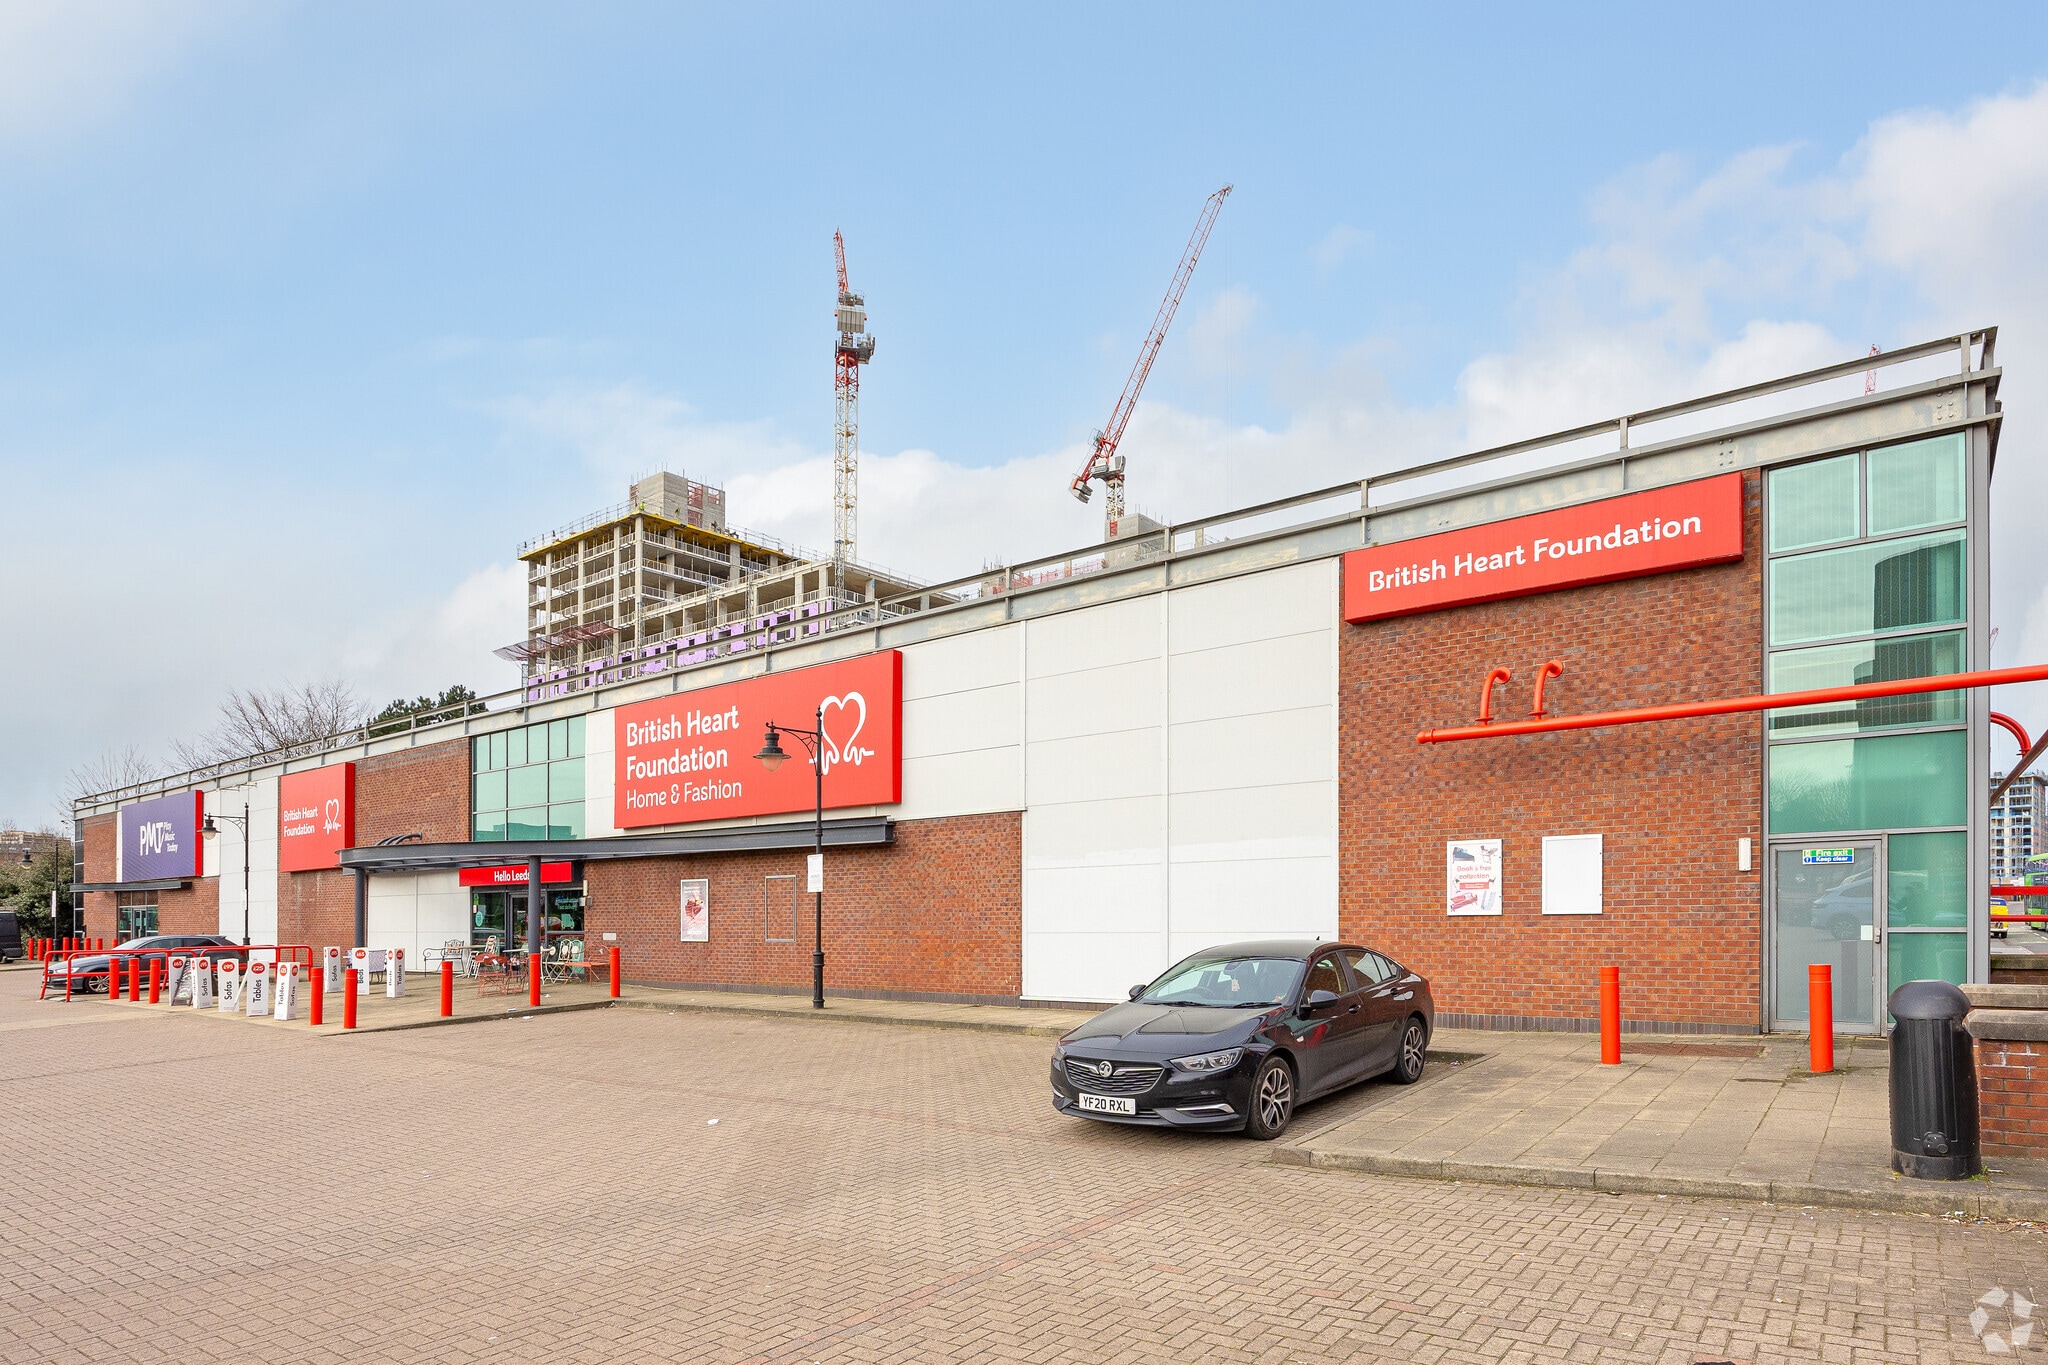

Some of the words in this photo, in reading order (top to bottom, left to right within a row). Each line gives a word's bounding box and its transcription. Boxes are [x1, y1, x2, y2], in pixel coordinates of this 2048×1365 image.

[1369, 559, 1446, 593] British
[1453, 545, 1526, 577] Heart
[1533, 515, 1702, 562] Foundation
[626, 713, 682, 747] British
[687, 705, 740, 737] Heart
[626, 745, 728, 780] Foundation
[626, 788, 667, 810] Home
[670, 783, 680, 805] &
[684, 778, 742, 803] Fashion
[283, 807, 302, 822] British
[302, 806, 319, 819] Heart
[164, 822, 172, 831] Play
[283, 823, 315, 838] Foundation
[140, 821, 165, 856] PMT
[165, 831, 175, 841] Music
[166, 842, 179, 854] Today
[1816, 849, 1831, 857] Fire
[1833, 848, 1848, 856] exit
[494, 870, 511, 882] Hello
[224, 980, 232, 1001] Sofas
[252, 979, 262, 1004] Tables
[1083, 1095, 1107, 1110] YF20
[1109, 1099, 1130, 1112] RXL
